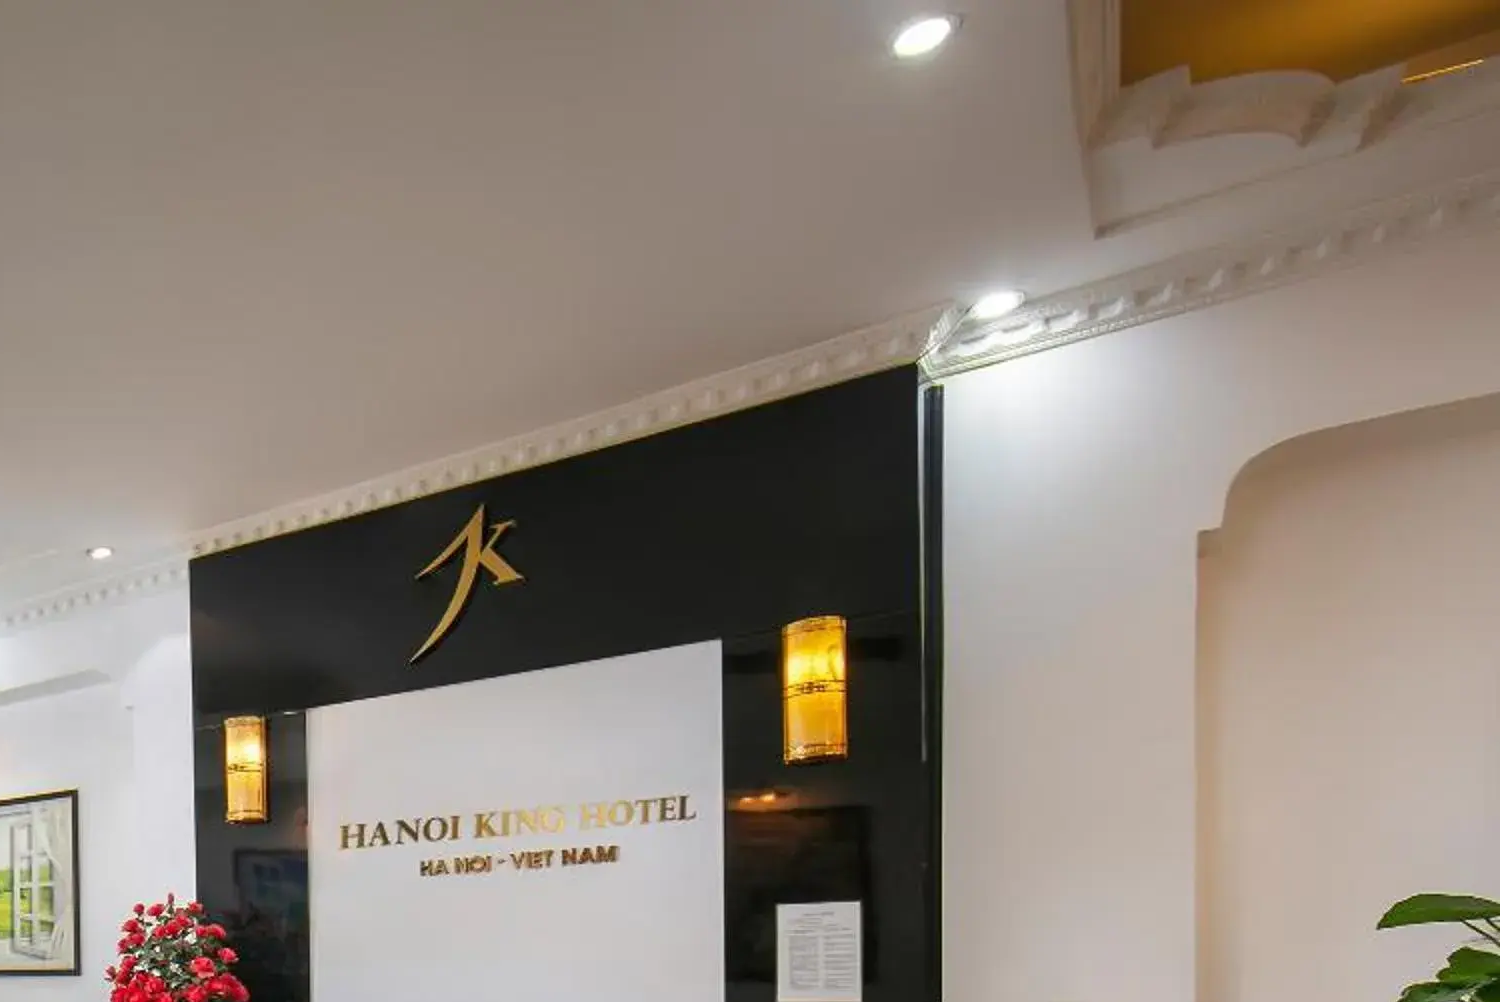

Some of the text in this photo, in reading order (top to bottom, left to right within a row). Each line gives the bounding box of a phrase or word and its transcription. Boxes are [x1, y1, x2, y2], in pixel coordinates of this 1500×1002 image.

[339, 794, 697, 850] HANOI KING HOTEL
[419, 858, 449, 877] HA
[454, 854, 493, 875] NOI
[509, 848, 555, 871] VIET
[561, 844, 621, 867] NAM
